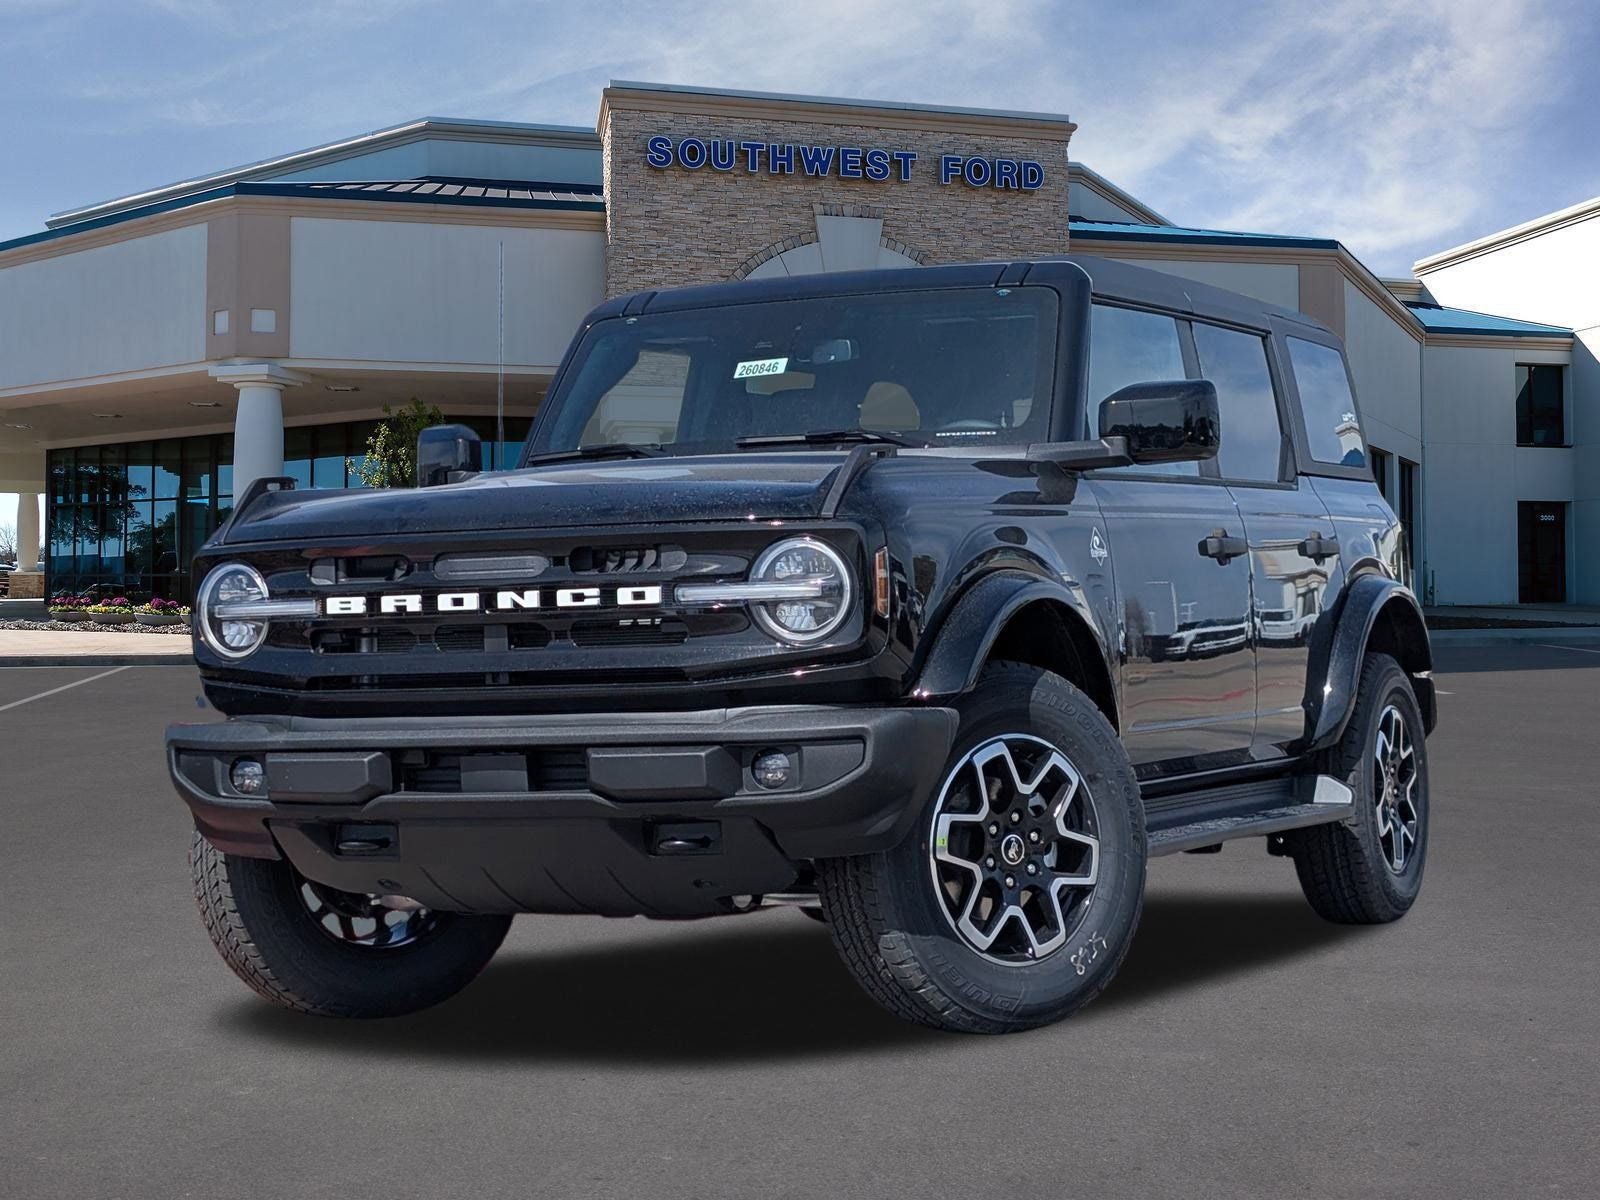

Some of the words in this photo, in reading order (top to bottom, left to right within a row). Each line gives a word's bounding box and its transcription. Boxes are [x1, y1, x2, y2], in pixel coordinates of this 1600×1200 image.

[647, 135, 918, 182] SOUTHWEST
[939, 156, 1045, 190] FORD
[738, 361, 780, 377] 260846
[326, 586, 662, 615] BRONCO
